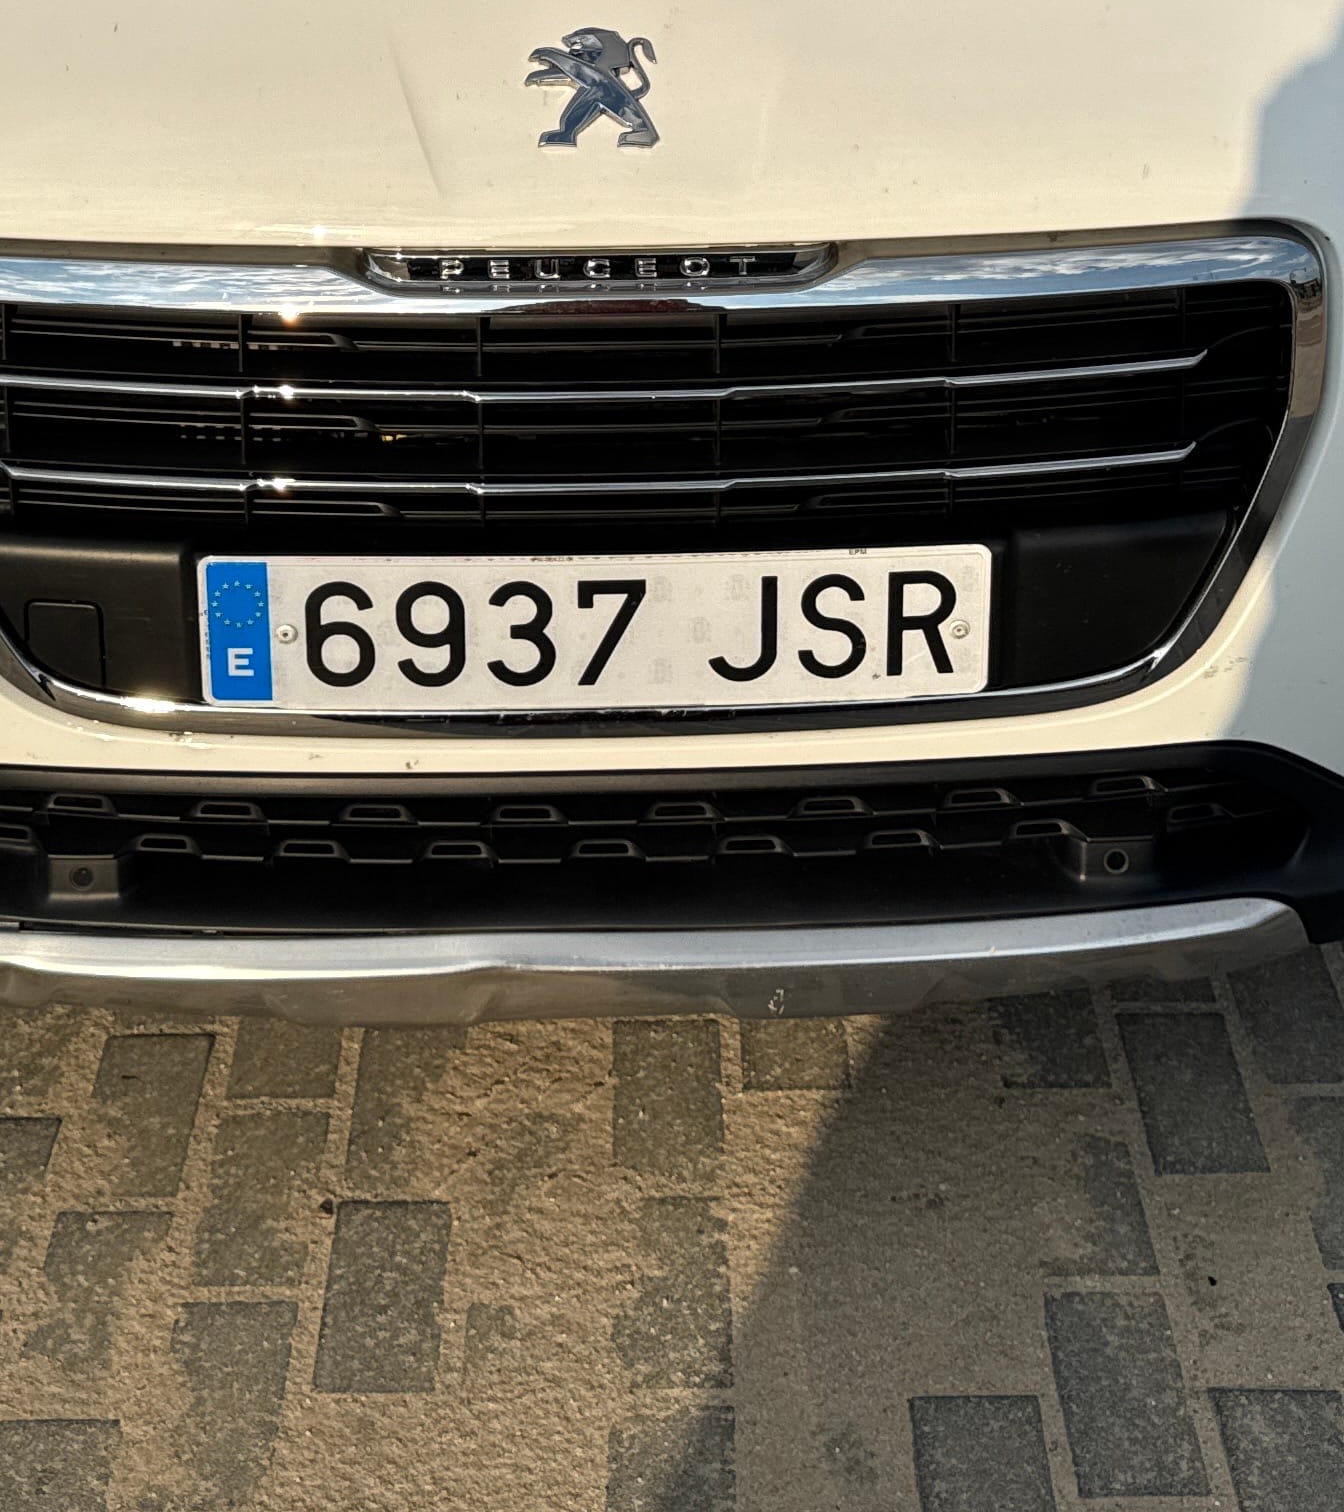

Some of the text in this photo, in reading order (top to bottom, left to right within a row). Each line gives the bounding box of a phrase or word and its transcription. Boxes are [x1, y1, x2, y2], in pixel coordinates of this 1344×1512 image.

[439, 256, 756, 280] PEUGEOT
[304, 579, 647, 687] 6937
[708, 570, 958, 682] JSR
[227, 648, 254, 676] E
